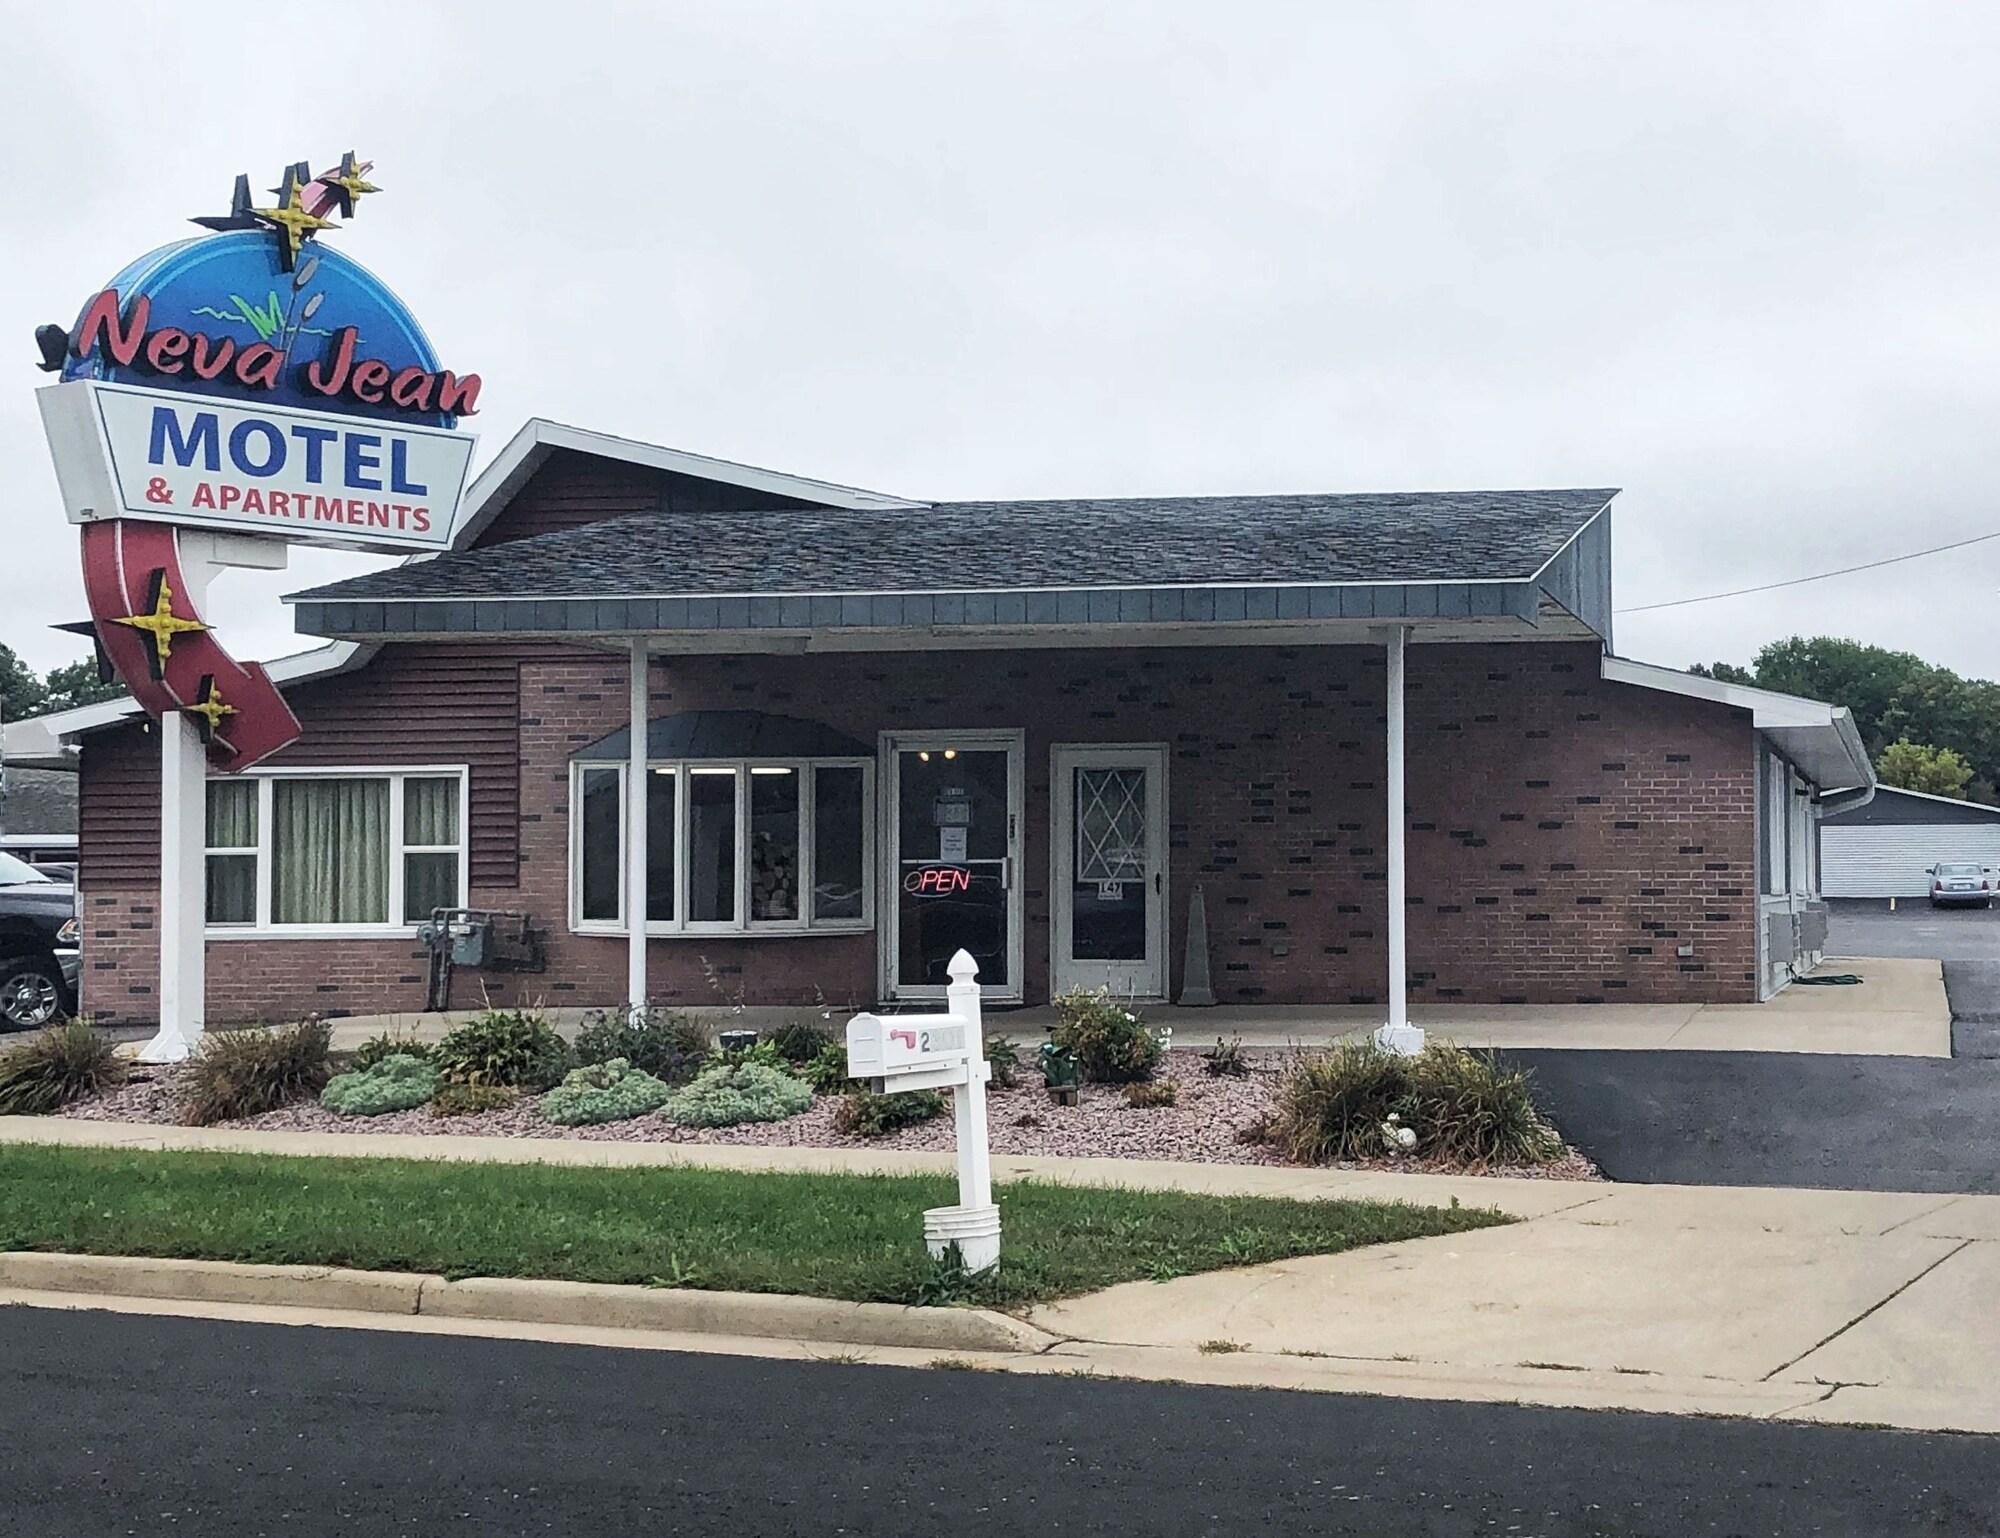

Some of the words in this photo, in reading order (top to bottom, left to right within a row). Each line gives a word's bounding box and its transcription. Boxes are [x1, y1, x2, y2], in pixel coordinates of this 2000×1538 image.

[79, 288, 286, 388] Neva
[308, 325, 481, 415] Jean
[148, 406, 429, 497] MOTEL
[146, 477, 174, 505] &
[191, 482, 431, 533] APARTMENTS
[904, 870, 970, 892] OPEN
